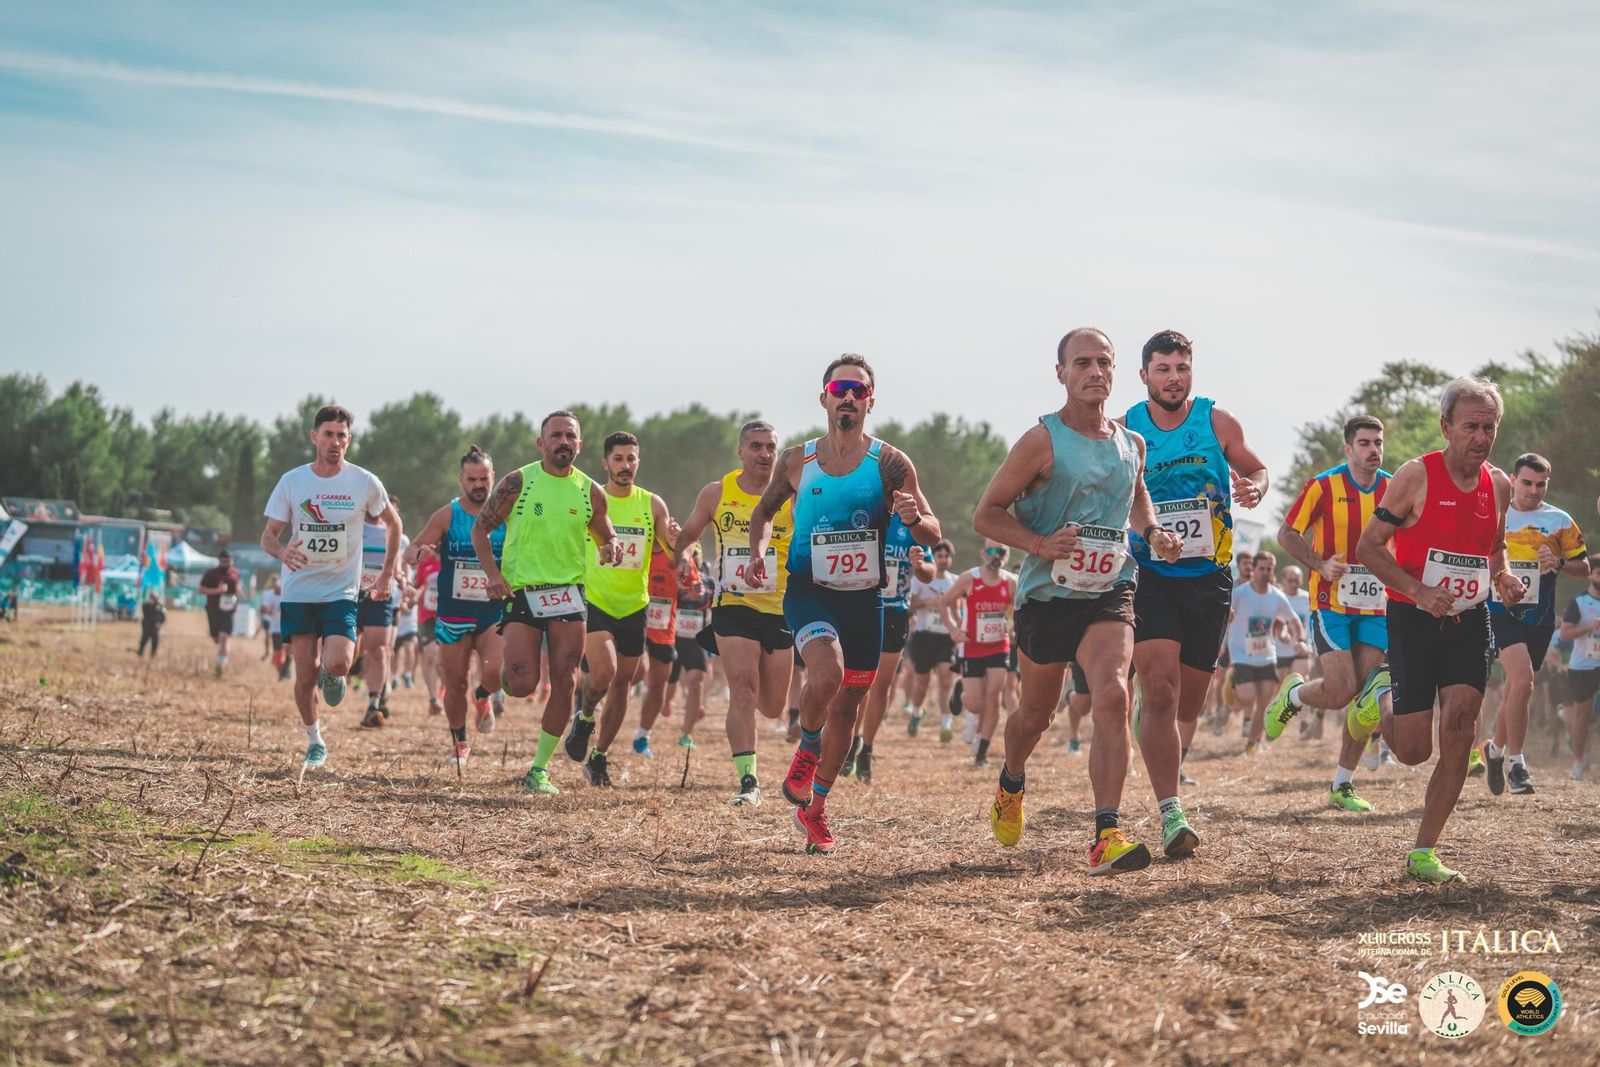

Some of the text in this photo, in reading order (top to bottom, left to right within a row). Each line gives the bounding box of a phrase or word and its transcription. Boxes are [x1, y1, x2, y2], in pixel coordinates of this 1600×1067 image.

[1164, 501, 1195, 512] ITÁLICA
[829, 532, 861, 542] ITÁLICA
[1082, 528, 1112, 539] ITÁLICA
[307, 538, 339, 553] 429
[618, 541, 637, 556] 14
[826, 552, 868, 575] 792
[1070, 549, 1115, 574] 316
[1447, 555, 1477, 566] ITÁLICA
[461, 576, 488, 590] 323
[1349, 580, 1378, 596] 146
[1437, 576, 1479, 600] 439
[538, 590, 573, 607] 154
[648, 608, 662, 620] 48
